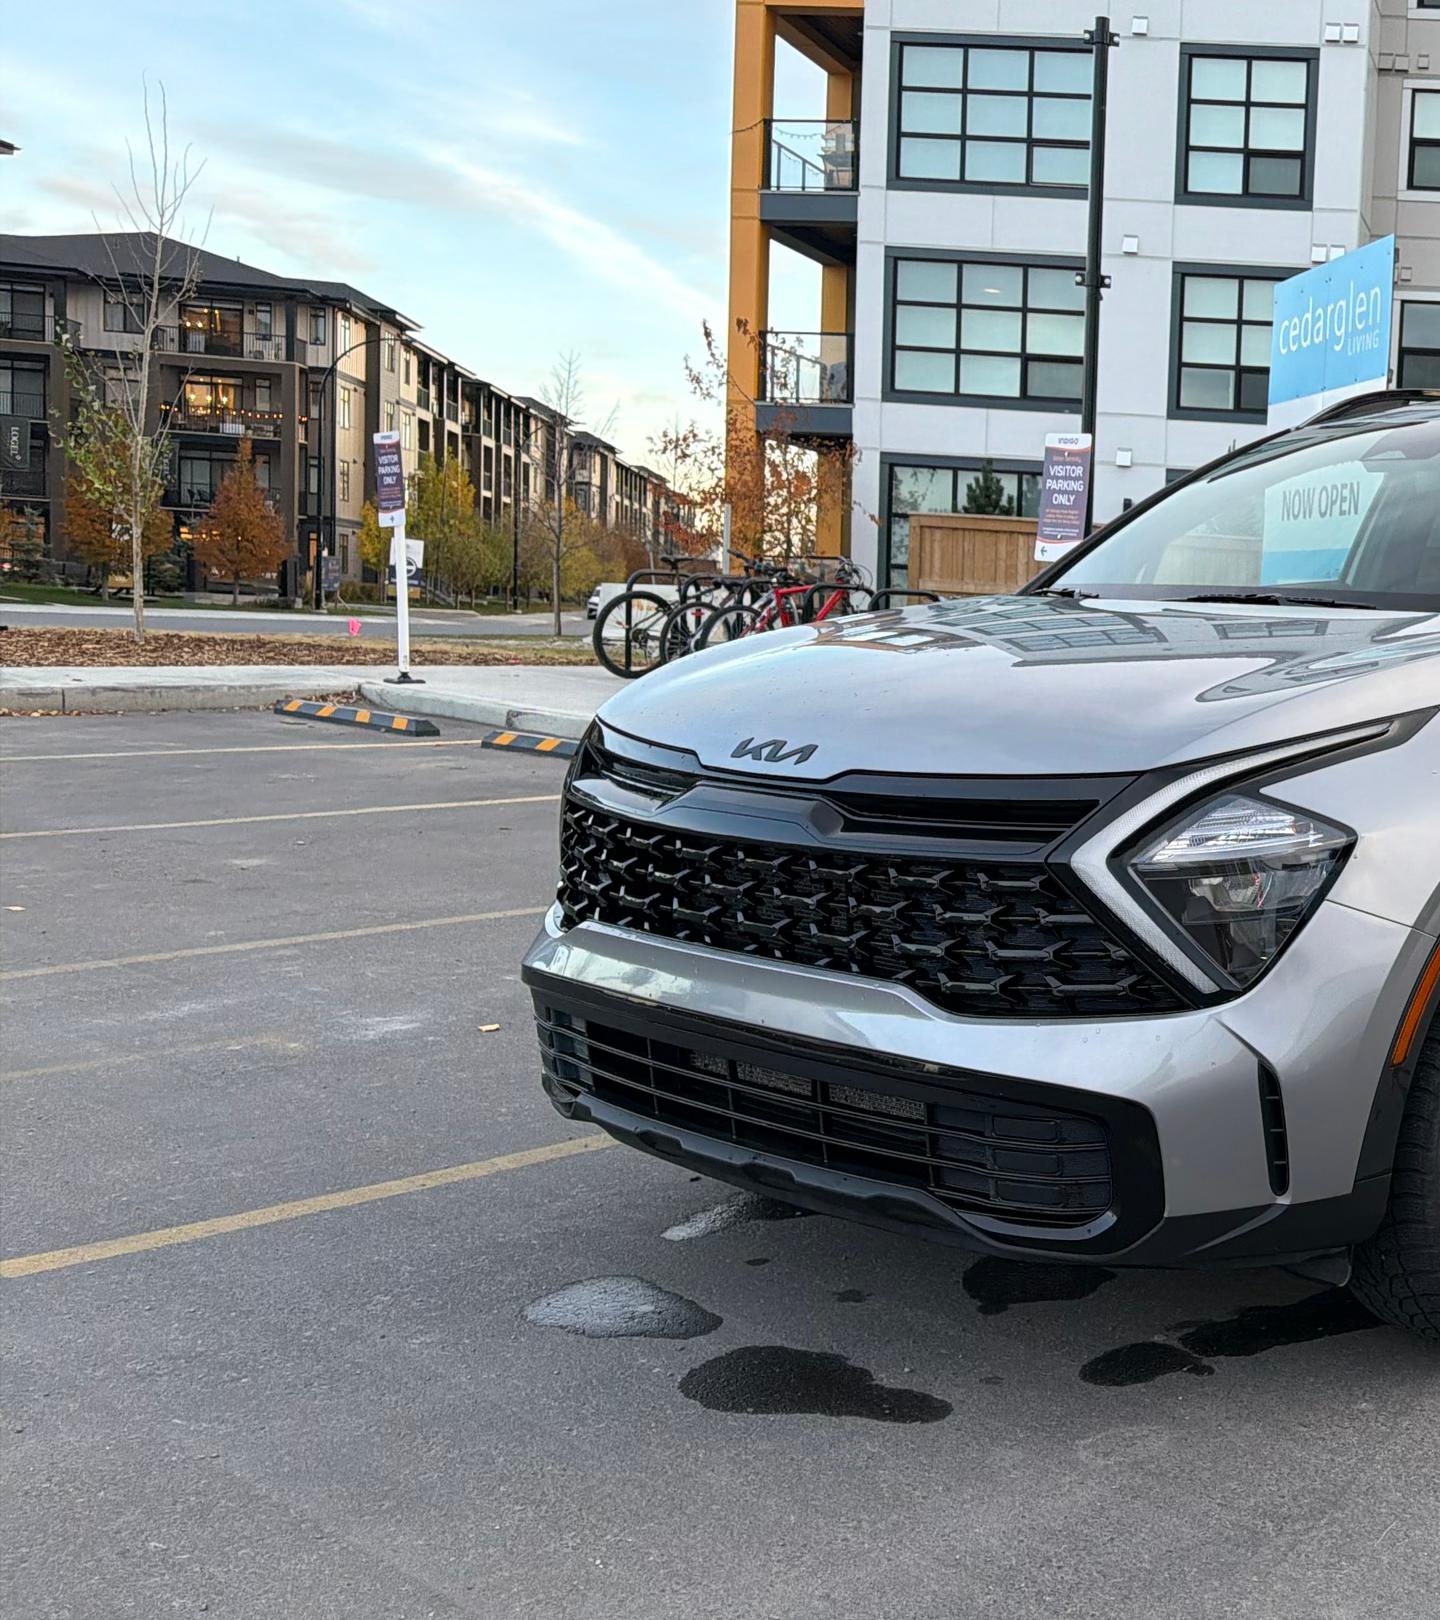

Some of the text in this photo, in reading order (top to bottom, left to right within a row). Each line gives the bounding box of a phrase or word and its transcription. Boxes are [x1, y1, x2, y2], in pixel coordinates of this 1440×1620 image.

[1279, 280, 1381, 355] cedarglen
[1347, 330, 1380, 356] LIVING
[378, 454, 399, 464] VISITOR
[378, 464, 400, 475] PARKING
[1049, 465, 1084, 478] VISITOR
[382, 475, 397, 485] ONLY
[1046, 479, 1084, 492] PARKING
[1052, 493, 1076, 506] ONLY
[1281, 481, 1360, 521] NOW OPEN
